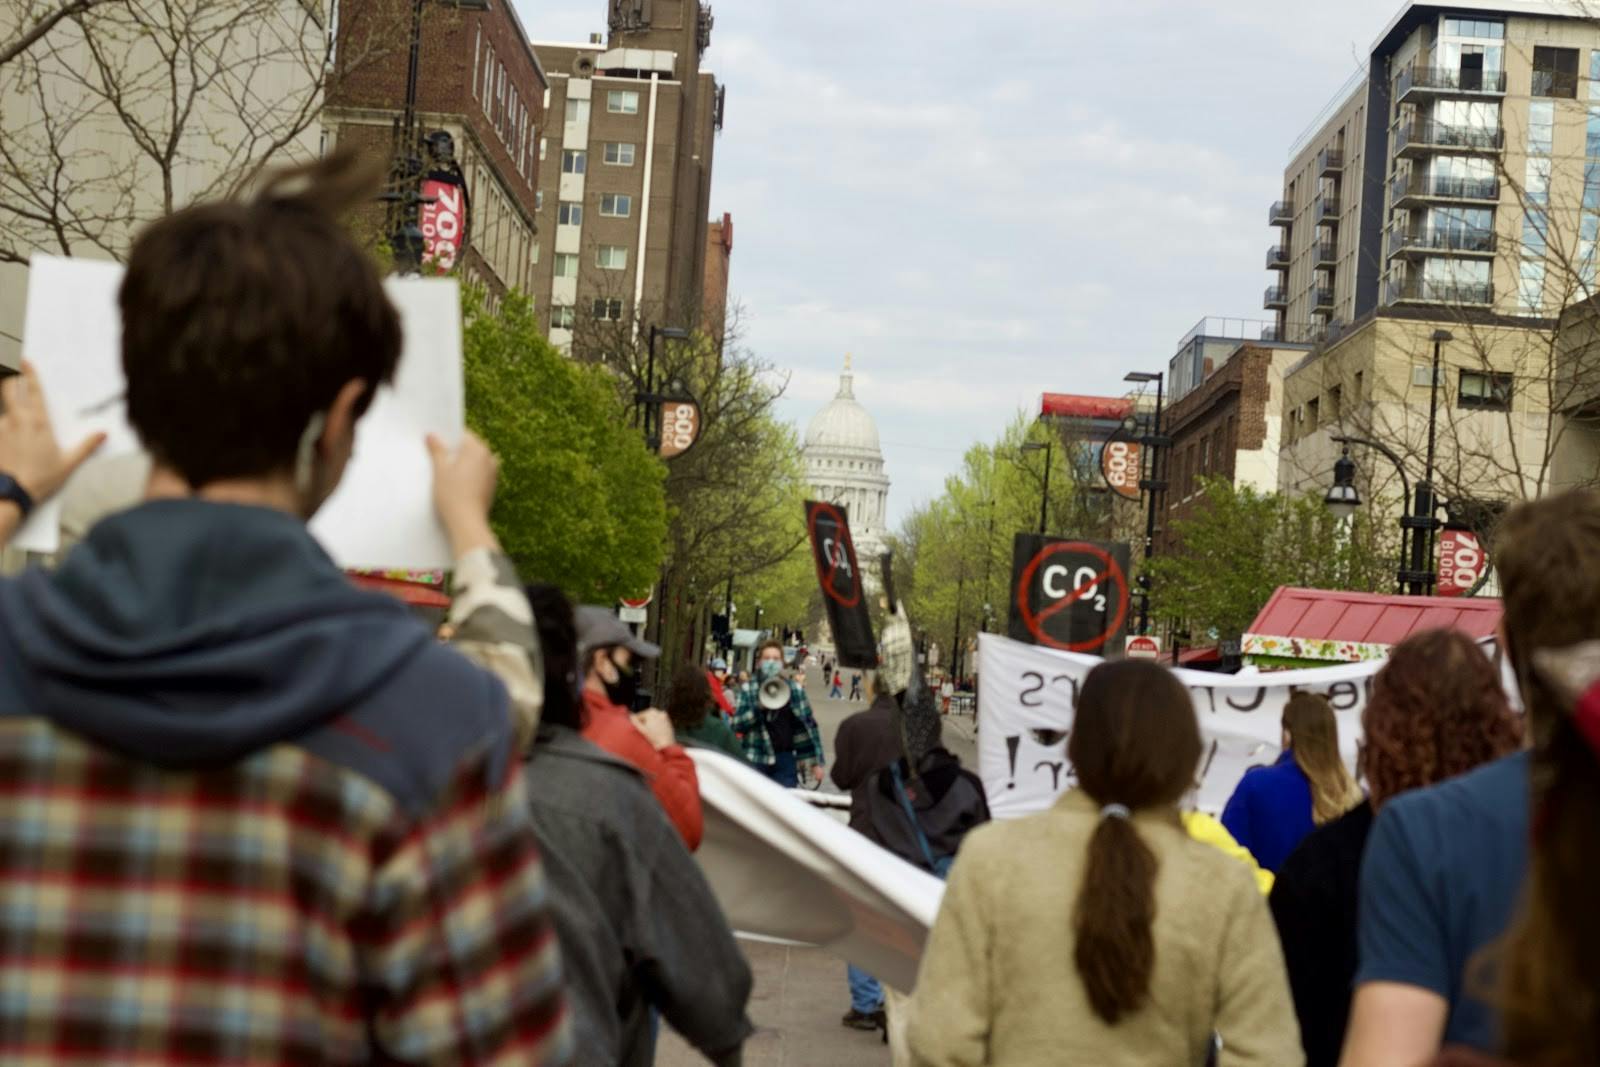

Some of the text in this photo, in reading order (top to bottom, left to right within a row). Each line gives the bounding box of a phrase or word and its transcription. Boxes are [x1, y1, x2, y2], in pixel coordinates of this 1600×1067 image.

[438, 187, 459, 269] 700
[675, 404, 694, 449] 600
[1108, 441, 1128, 486] 600
[1440, 540, 1455, 587] BLOCK
[1454, 532, 1479, 588] 700
[1042, 564, 1106, 612] CO2
